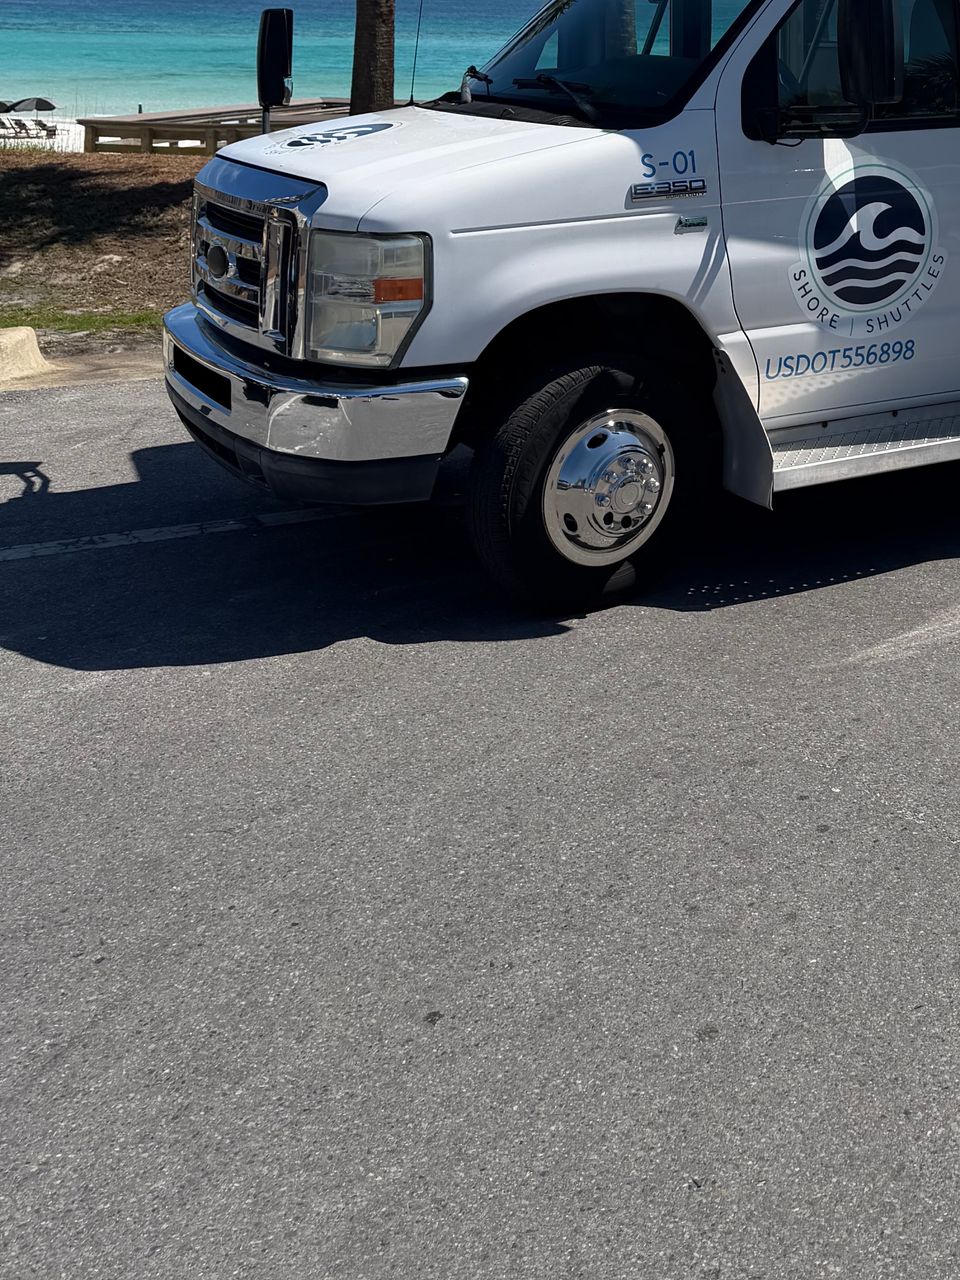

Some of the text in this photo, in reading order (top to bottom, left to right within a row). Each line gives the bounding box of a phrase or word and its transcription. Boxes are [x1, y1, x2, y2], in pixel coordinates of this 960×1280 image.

[640, 149, 697, 179] S-01
[793, 254, 945, 333] SHORE SHUTTLES
[765, 339, 915, 380] USDOT556898
